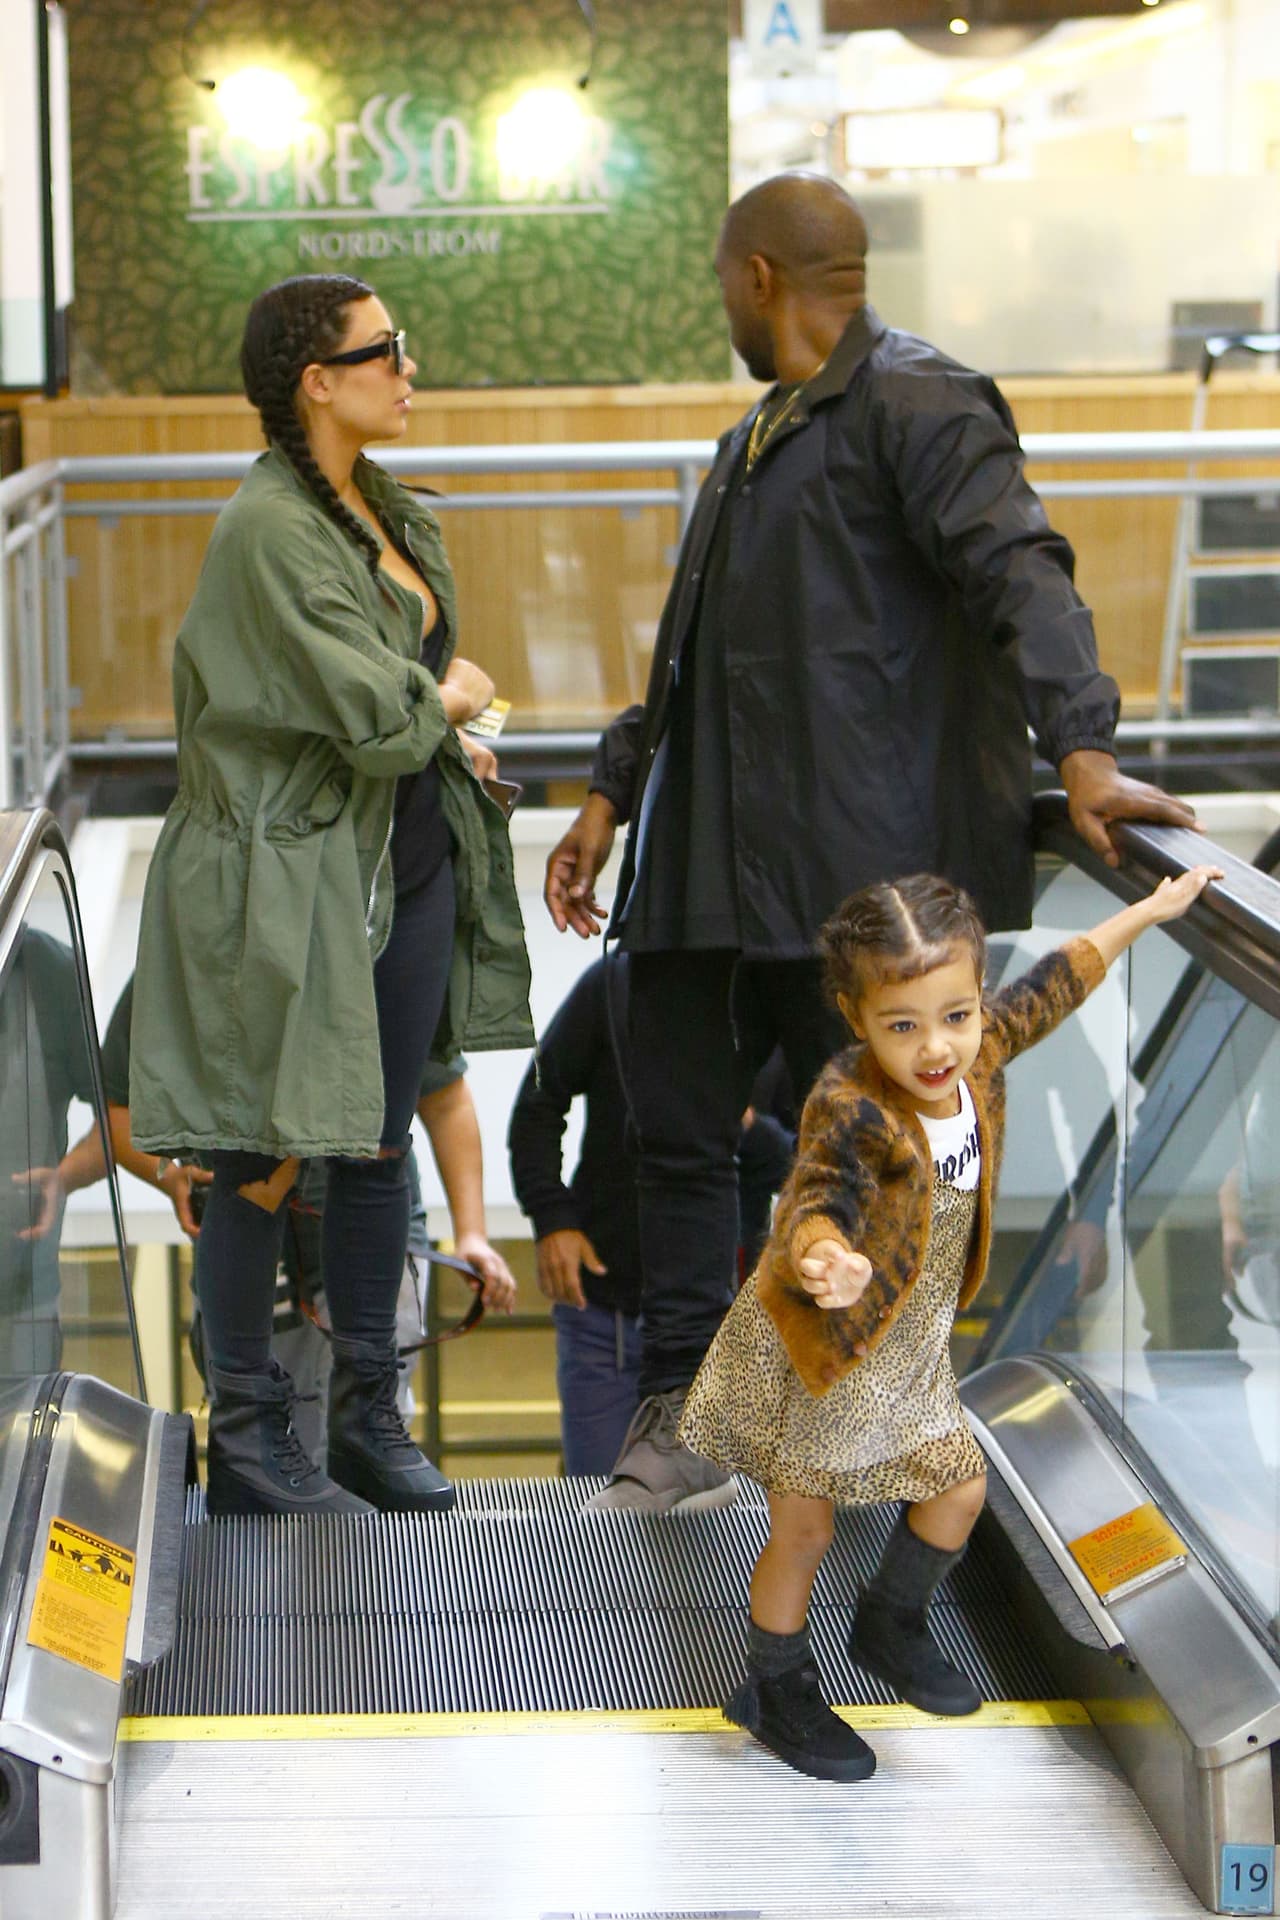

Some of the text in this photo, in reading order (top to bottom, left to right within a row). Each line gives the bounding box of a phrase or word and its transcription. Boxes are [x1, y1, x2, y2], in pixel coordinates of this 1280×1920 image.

[763, 2, 801, 47] A
[185, 93, 470, 213] ESPRESSO
[299, 228, 501, 260] NORDSTROM
[64, 1527, 122, 1557] CAUTION
[1230, 1862, 1268, 1893] 19
